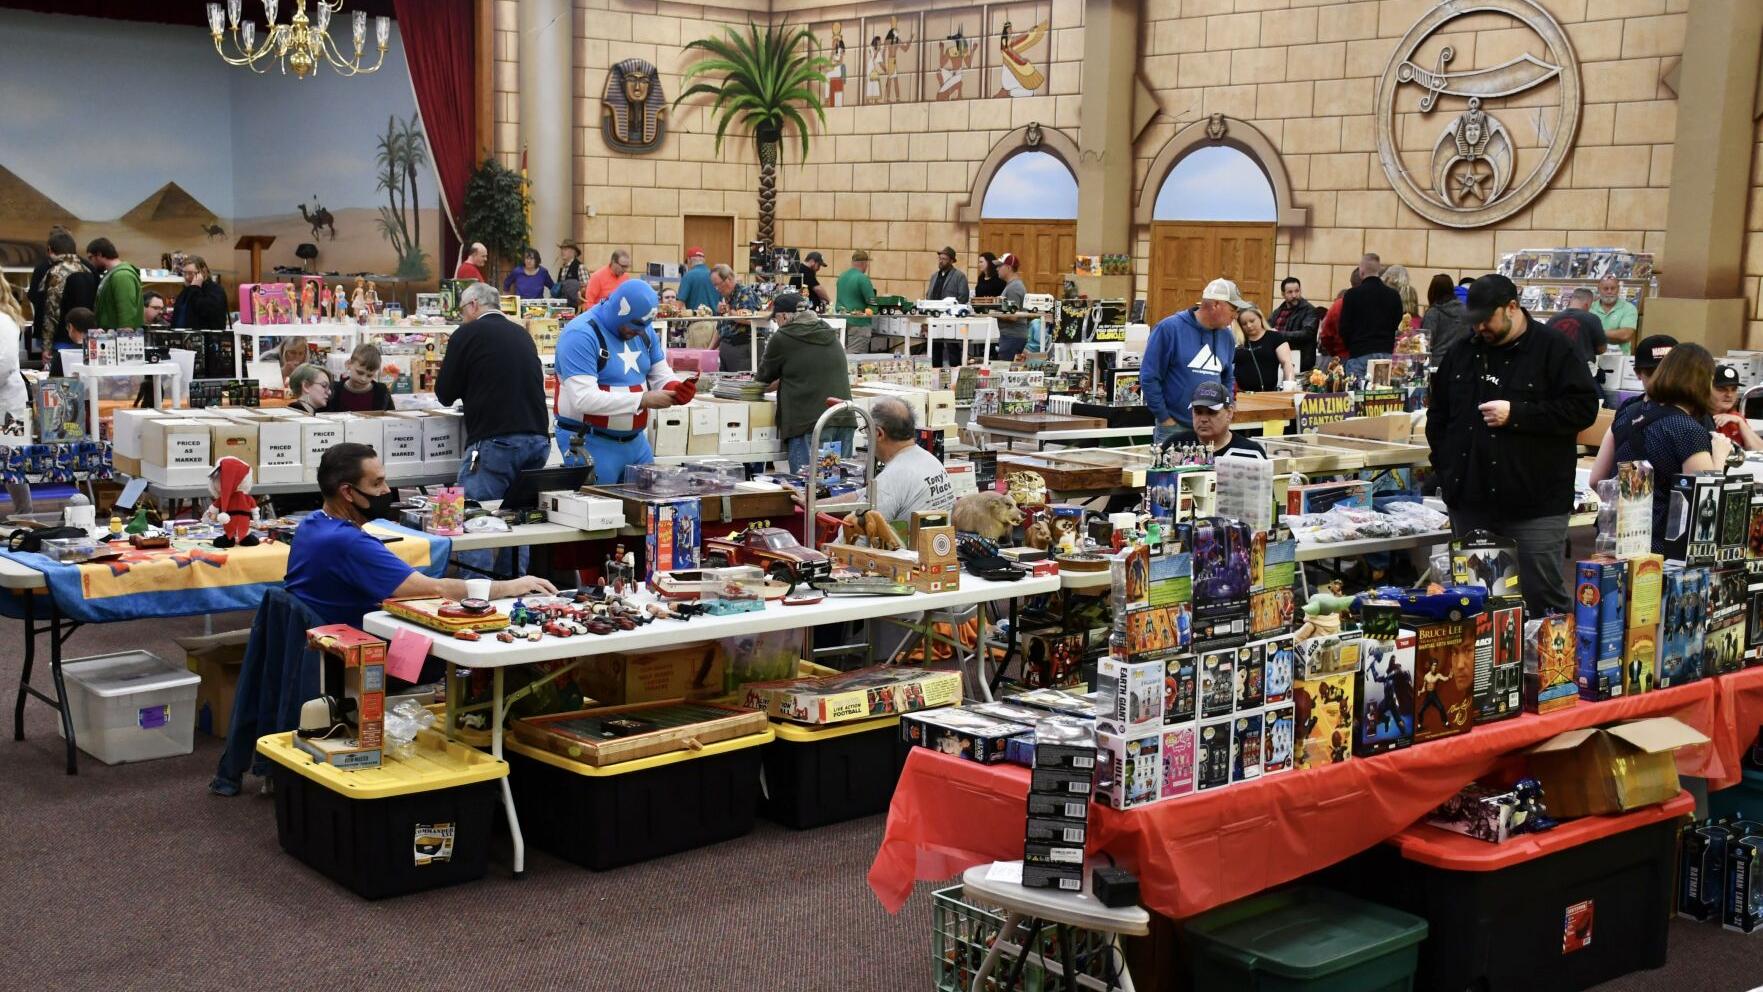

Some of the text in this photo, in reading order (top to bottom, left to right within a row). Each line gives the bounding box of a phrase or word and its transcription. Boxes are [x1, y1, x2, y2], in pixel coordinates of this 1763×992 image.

[1301, 396, 1352, 415] AMAZING
[1419, 628, 1446, 640] BRUCE
[1448, 625, 1462, 635] LEE
[1118, 666, 1128, 724] EARTH GIANT
[833, 708, 862, 718] FOOTBALL
[1114, 757, 1123, 788] HULK
[1689, 866, 1698, 898] BATMAN
[1735, 860, 1745, 889] BATMAN
[1735, 891, 1743, 914] EARTH
